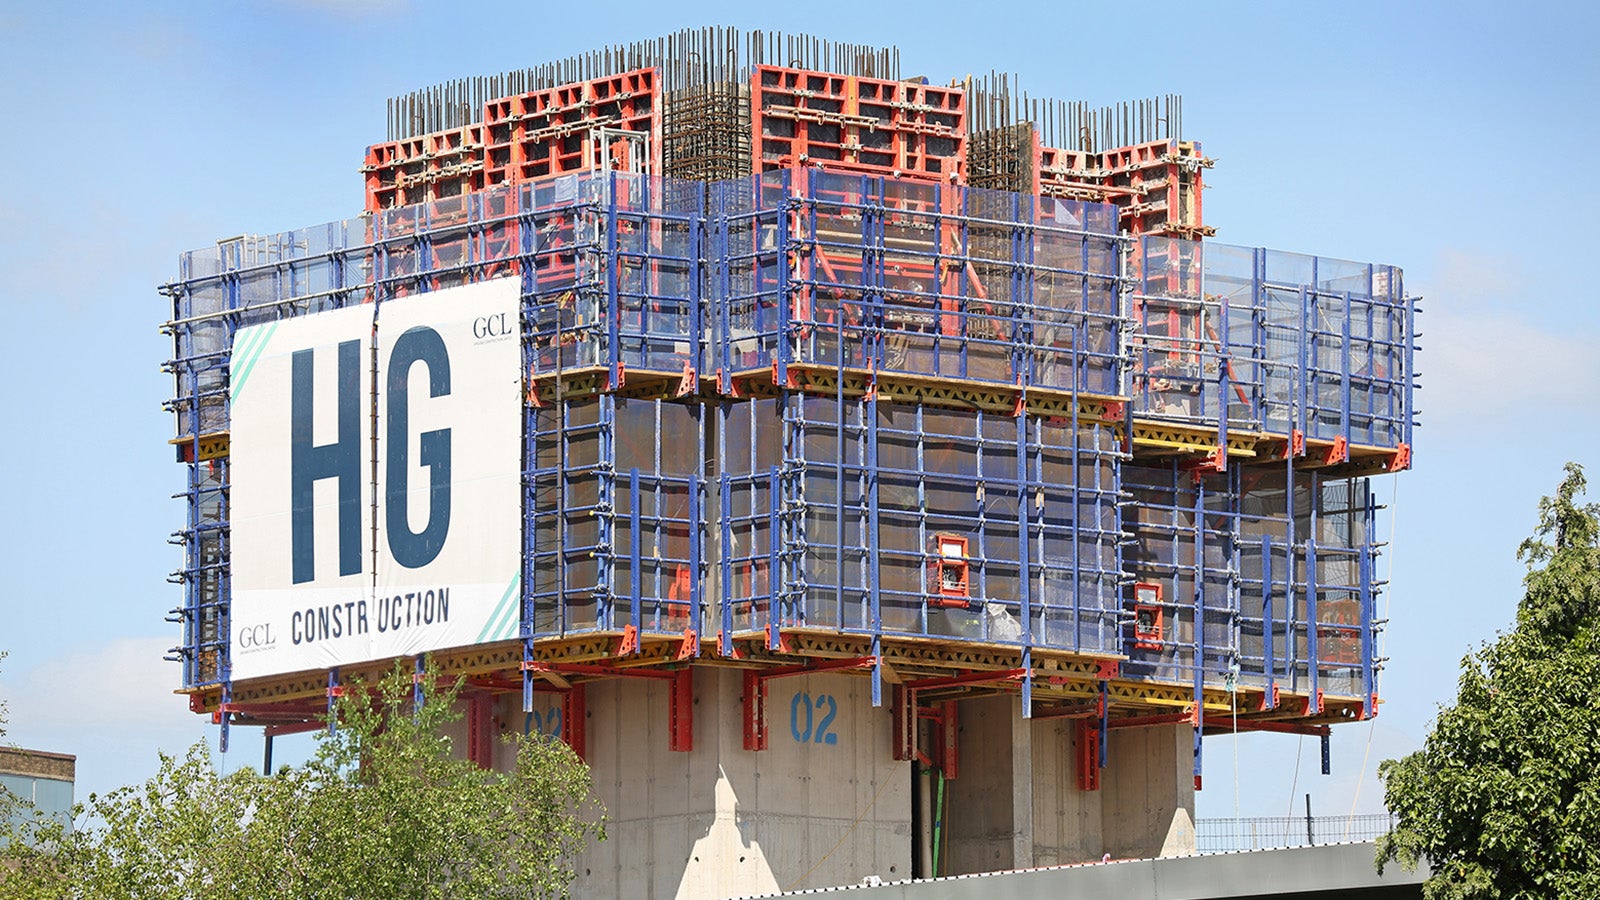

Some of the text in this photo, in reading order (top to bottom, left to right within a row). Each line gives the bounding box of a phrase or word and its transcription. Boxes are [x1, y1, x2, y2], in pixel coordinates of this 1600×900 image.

[473, 312, 512, 339] GCL
[292, 325, 452, 585] HG
[239, 623, 276, 648] GCL
[292, 587, 450, 645] CONSTRUCTION
[790, 691, 837, 744] 02
